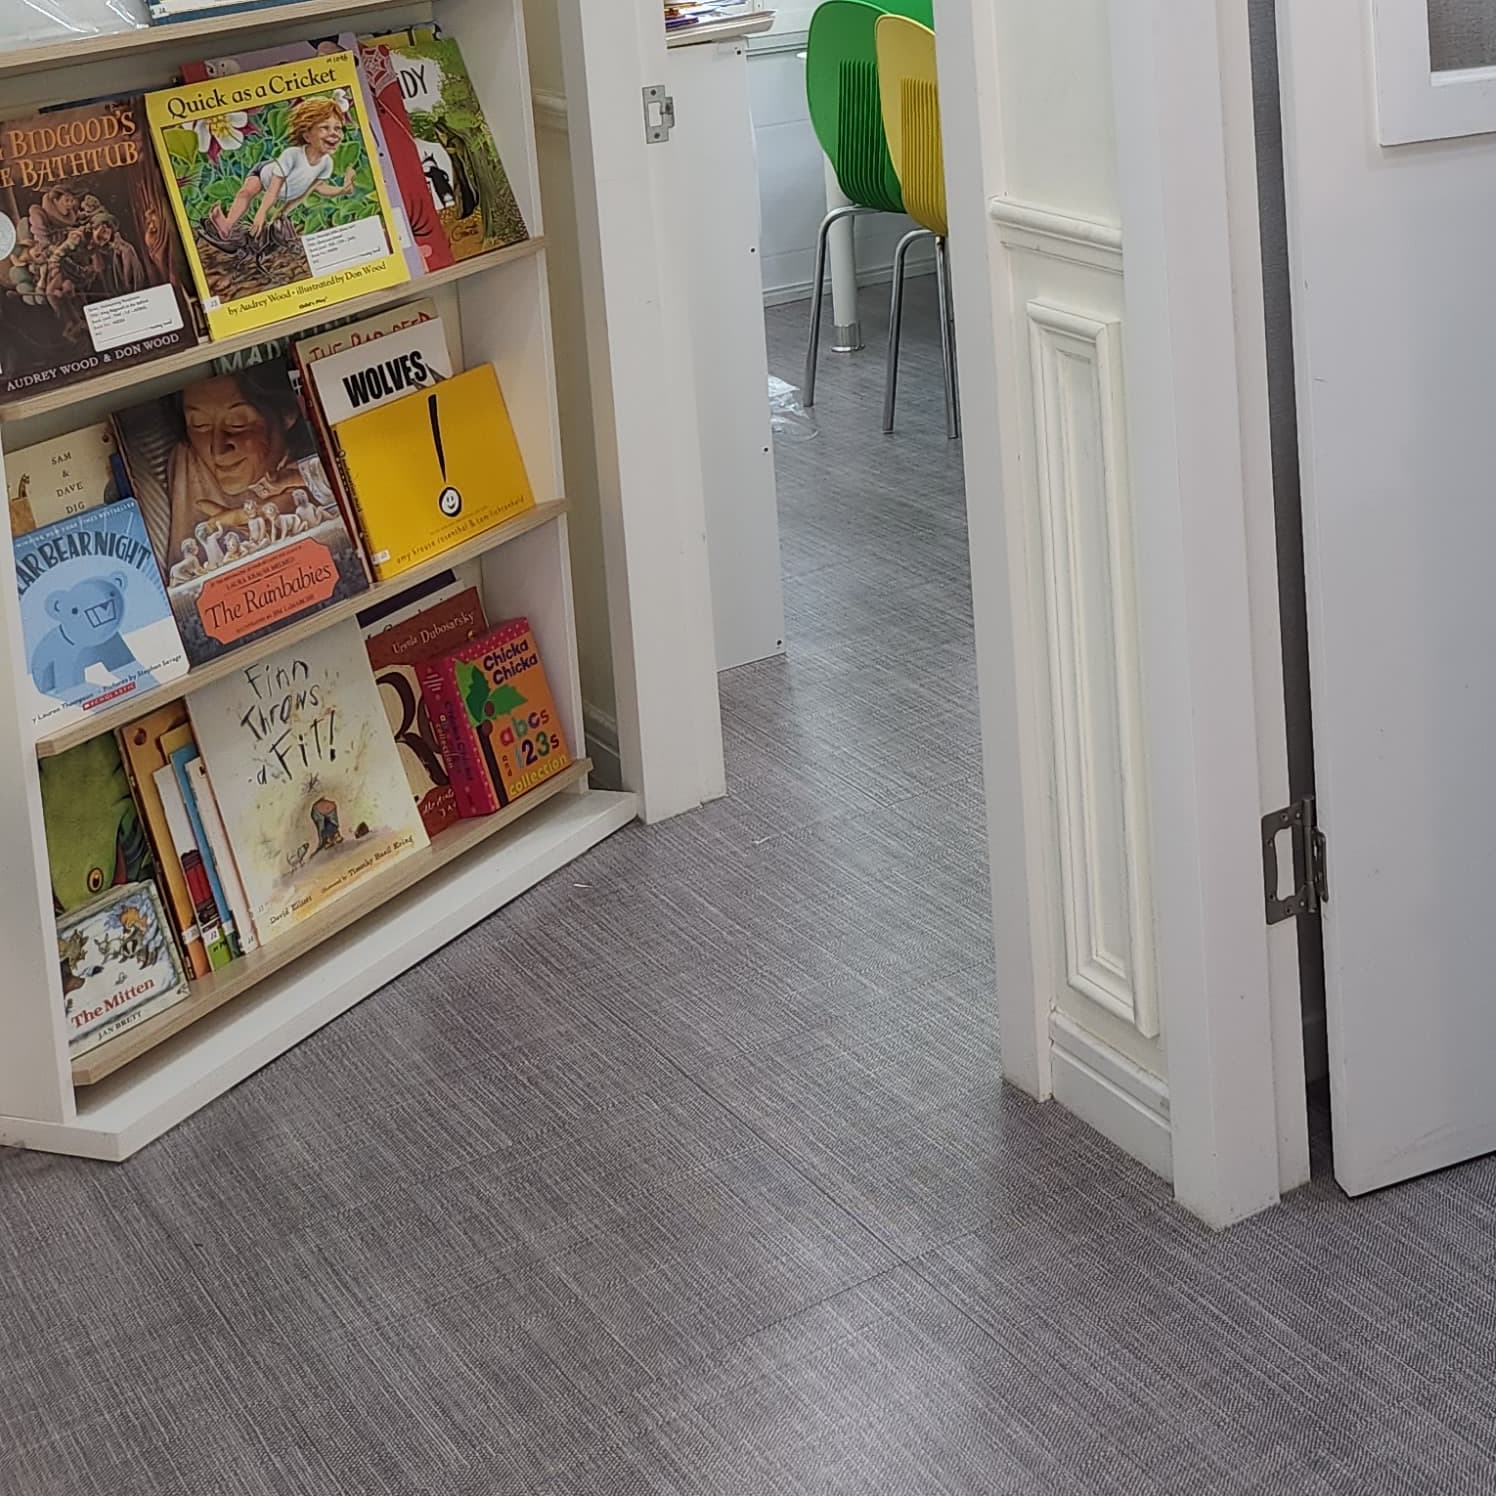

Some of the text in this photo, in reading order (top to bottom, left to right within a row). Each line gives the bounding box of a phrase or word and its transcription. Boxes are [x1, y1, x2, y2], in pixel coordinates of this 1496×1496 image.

[167, 67, 337, 120] Quick as a Cricket
[8, 107, 137, 160] BIDGOOD'S
[19, 140, 140, 192] BATHTUB
[227, 260, 387, 317] by Audrey Wood illustrated by Don Wood
[7, 333, 180, 392] AUDREY WOOD & DON WOOD
[342, 349, 429, 408] WOLVES
[51, 452, 72, 466] SAM
[62, 468, 70, 479] &
[56, 481, 84, 499] DAVE
[65, 501, 86, 515] DIG
[38, 531, 152, 571] BEAR NIGHT
[205, 563, 332, 631] The Rainbabies
[419, 609, 476, 642] Dubosarsky
[482, 637, 529, 672] Chicka
[492, 651, 538, 686] Chicka
[244, 659, 309, 700] Finn
[499, 708, 551, 747] abcs
[508, 753, 568, 796] collection
[71, 977, 156, 1029] The Mitten
[98, 1011, 143, 1040] JAN BRETT
